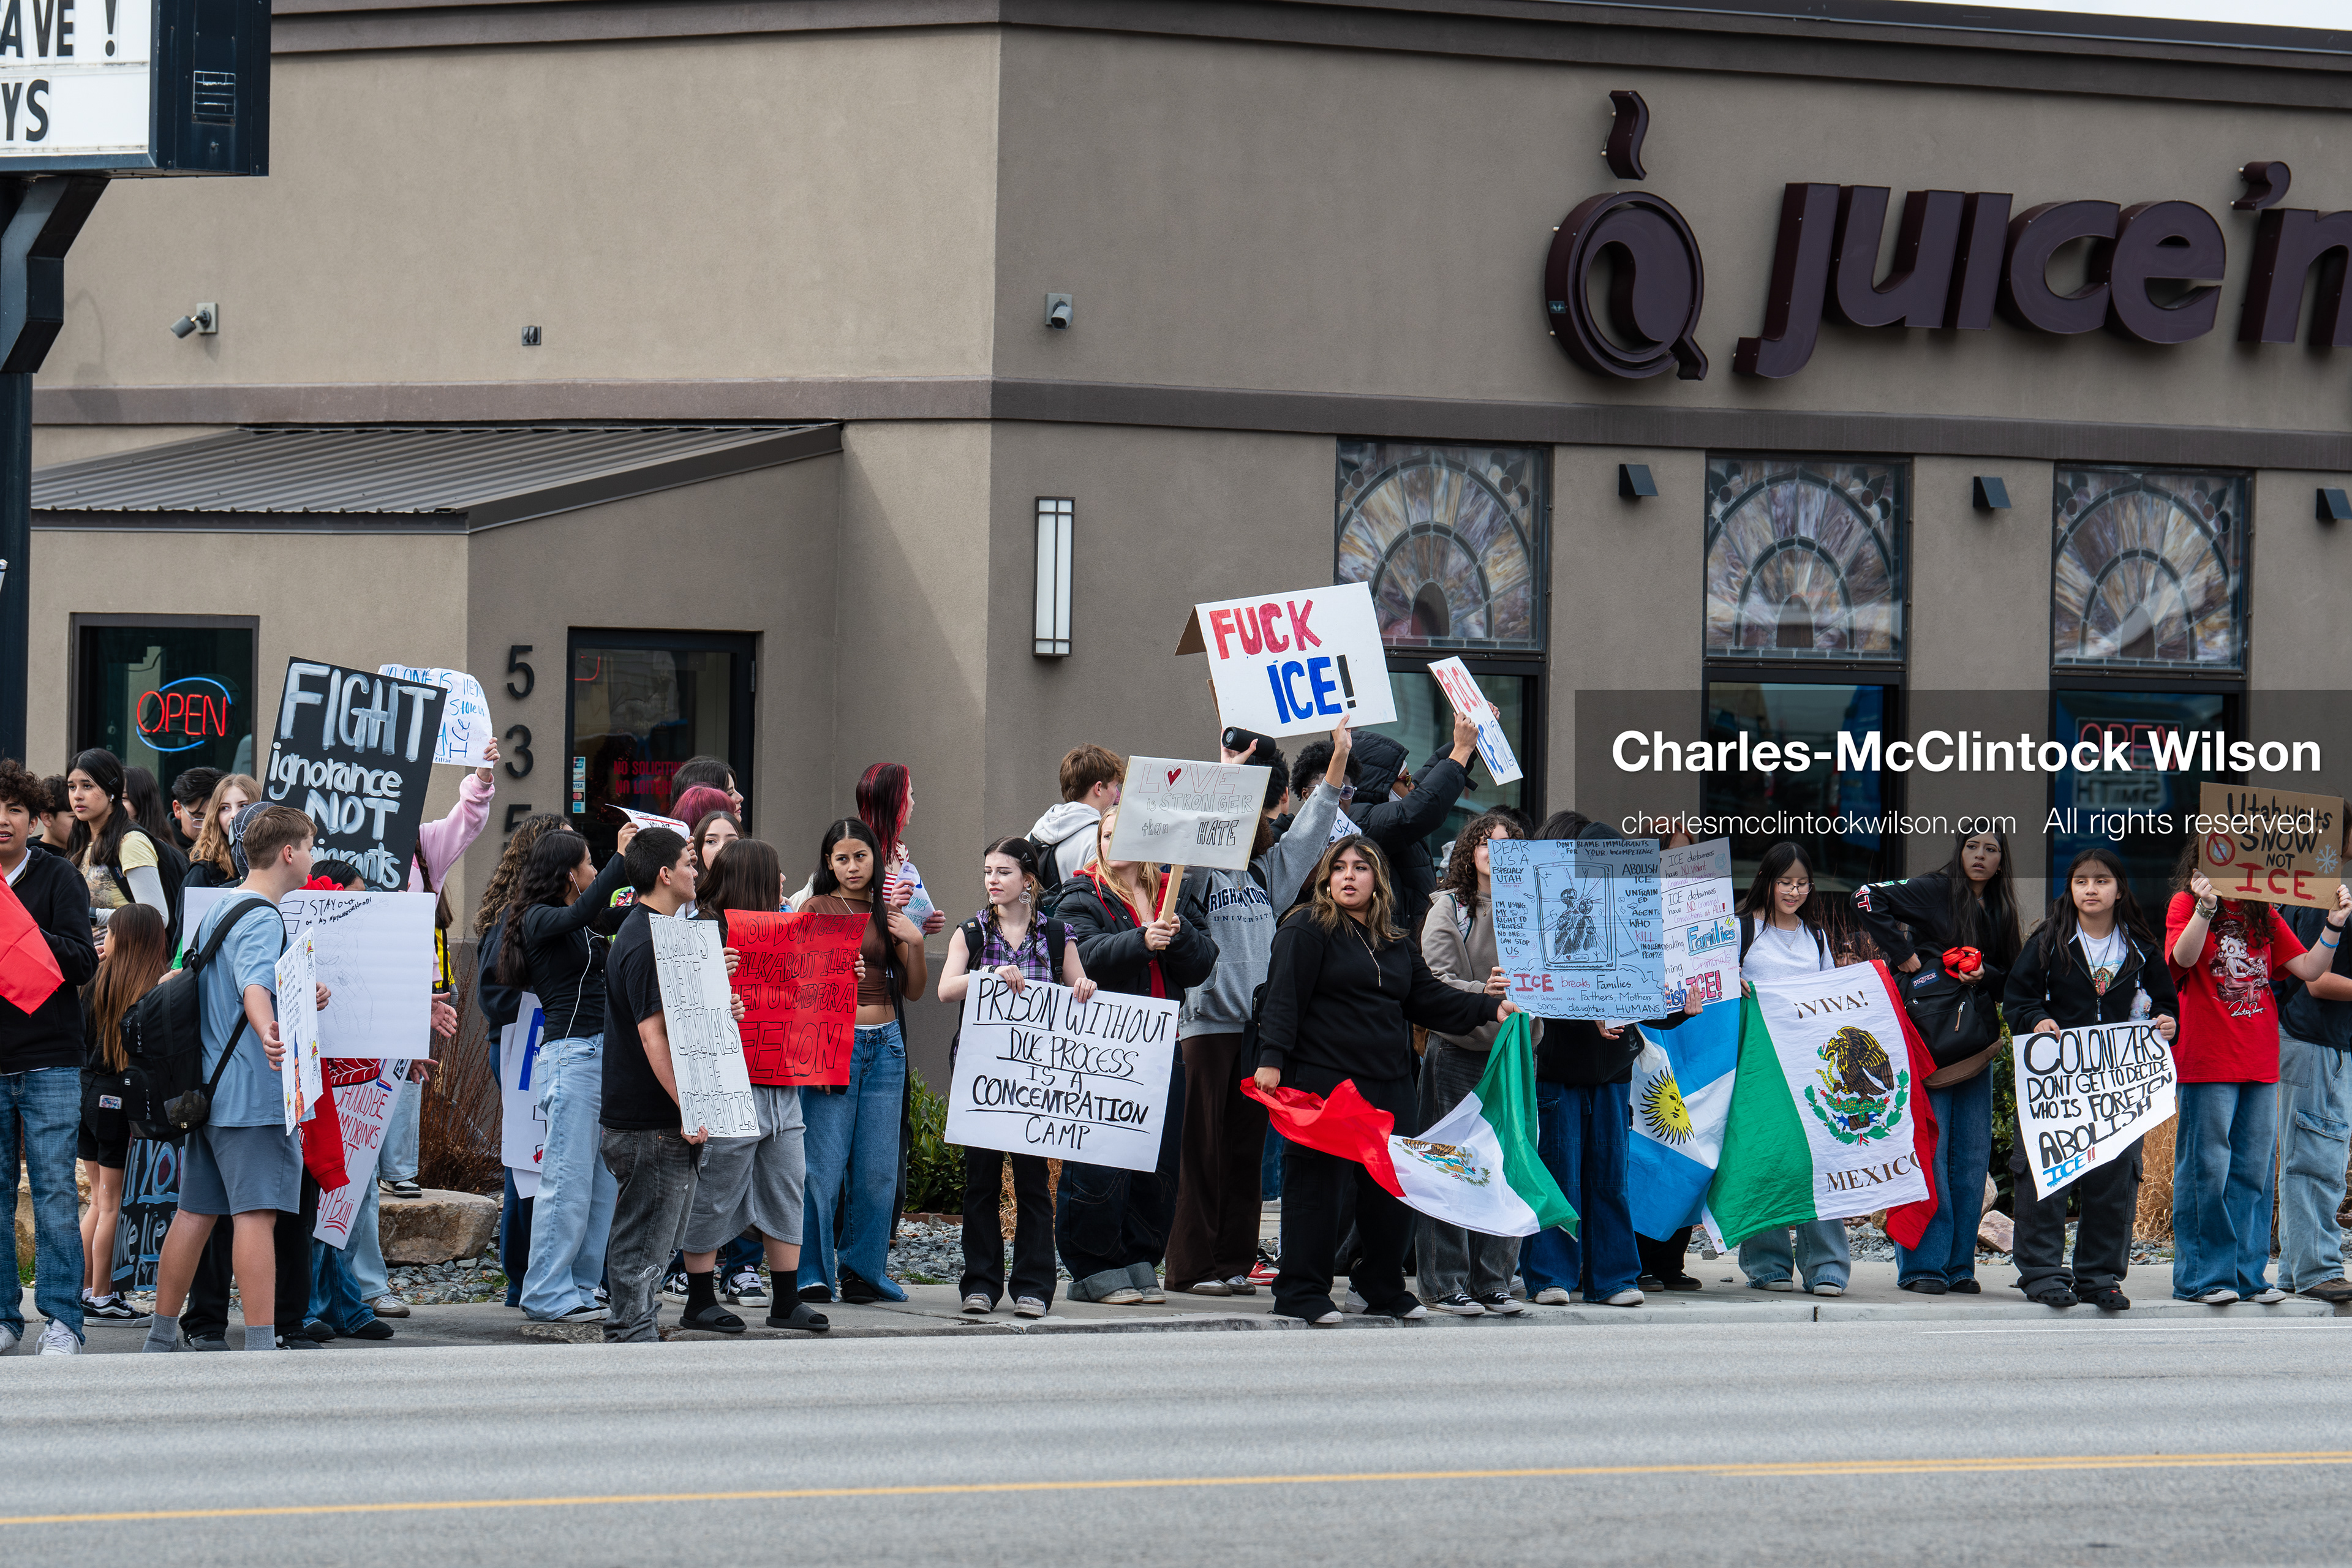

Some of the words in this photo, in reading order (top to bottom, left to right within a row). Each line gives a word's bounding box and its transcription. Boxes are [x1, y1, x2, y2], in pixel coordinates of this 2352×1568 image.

[1209, 599, 1322, 660] FUCK
[1267, 654, 1357, 725] ICE!
[137, 690, 227, 737] OPEN
[281, 662, 437, 763] FIGHT
[268, 742, 402, 800] ignorance
[614, 761, 628, 775] NO
[632, 761, 687, 775] SOLICITIN
[616, 780, 630, 794] NO
[304, 789, 401, 840] NOT
[1146, 797, 1157, 812] is
[1159, 793, 1254, 814] STRONGER
[2227, 792, 2282, 823] Utah
[1142, 818, 1169, 837] than
[1196, 820, 1239, 846] HATE
[1602, 840, 1649, 848] IMMIGRANTS
[2239, 825, 2318, 854] SNOW
[1492, 840, 1531, 855] DEAR
[1668, 853, 1684, 867] ICE
[1687, 850, 1714, 863] detainees
[2266, 853, 2296, 870] NOT
[1496, 875, 1522, 883] UTAH
[1622, 863, 1659, 876] ABOLISH
[1665, 869, 1679, 879] have
[1681, 864, 1690, 876] NO
[2234, 862, 2316, 901] ICE
[309, 898, 336, 916] STAY
[1625, 888, 1659, 897] UNTRAIN
[1668, 890, 1684, 906] ICE
[1687, 888, 1717, 901] detainees
[1667, 907, 1682, 916] have
[1686, 900, 1697, 913] NO
[730, 912, 770, 946] YOU
[845, 916, 867, 941] TO
[1629, 919, 1651, 928] WHO
[1635, 930, 1655, 942] KILL
[1687, 920, 1736, 952] Families
[764, 951, 820, 982] ABOUT
[1513, 973, 1555, 992] ICE
[1561, 976, 1591, 988] breaks
[1619, 992, 1652, 1002] Mothers
[767, 986, 781, 1010] U
[835, 983, 855, 1013] A
[977, 978, 1060, 1031] PRISON
[1065, 992, 1172, 1044] WITHOUT
[1793, 990, 1869, 1019] ¡VIVA!
[1009, 1027, 1044, 1062] DUE
[1050, 1035, 1139, 1077] PROCESS
[2023, 1024, 2166, 1076] COLONIZERS
[1025, 1066, 1056, 1086] IS
[1070, 1071, 1083, 1094] A
[2075, 1071, 2106, 1094] GET
[2108, 1068, 2124, 1088] TO
[2127, 1058, 2169, 1084] DECIDE
[369, 1088, 388, 1120] BE
[734, 1091, 757, 1131] IS
[972, 1074, 1150, 1125] CONCENTRATION
[2029, 1098, 2059, 1120] WHO
[2060, 1098, 2082, 1119] IS
[2087, 1071, 2173, 1122] FOREIGN
[349, 1117, 381, 1150] DRINKS
[1025, 1115, 1091, 1150] CAMP
[2038, 1095, 2152, 1169] ABOLISH
